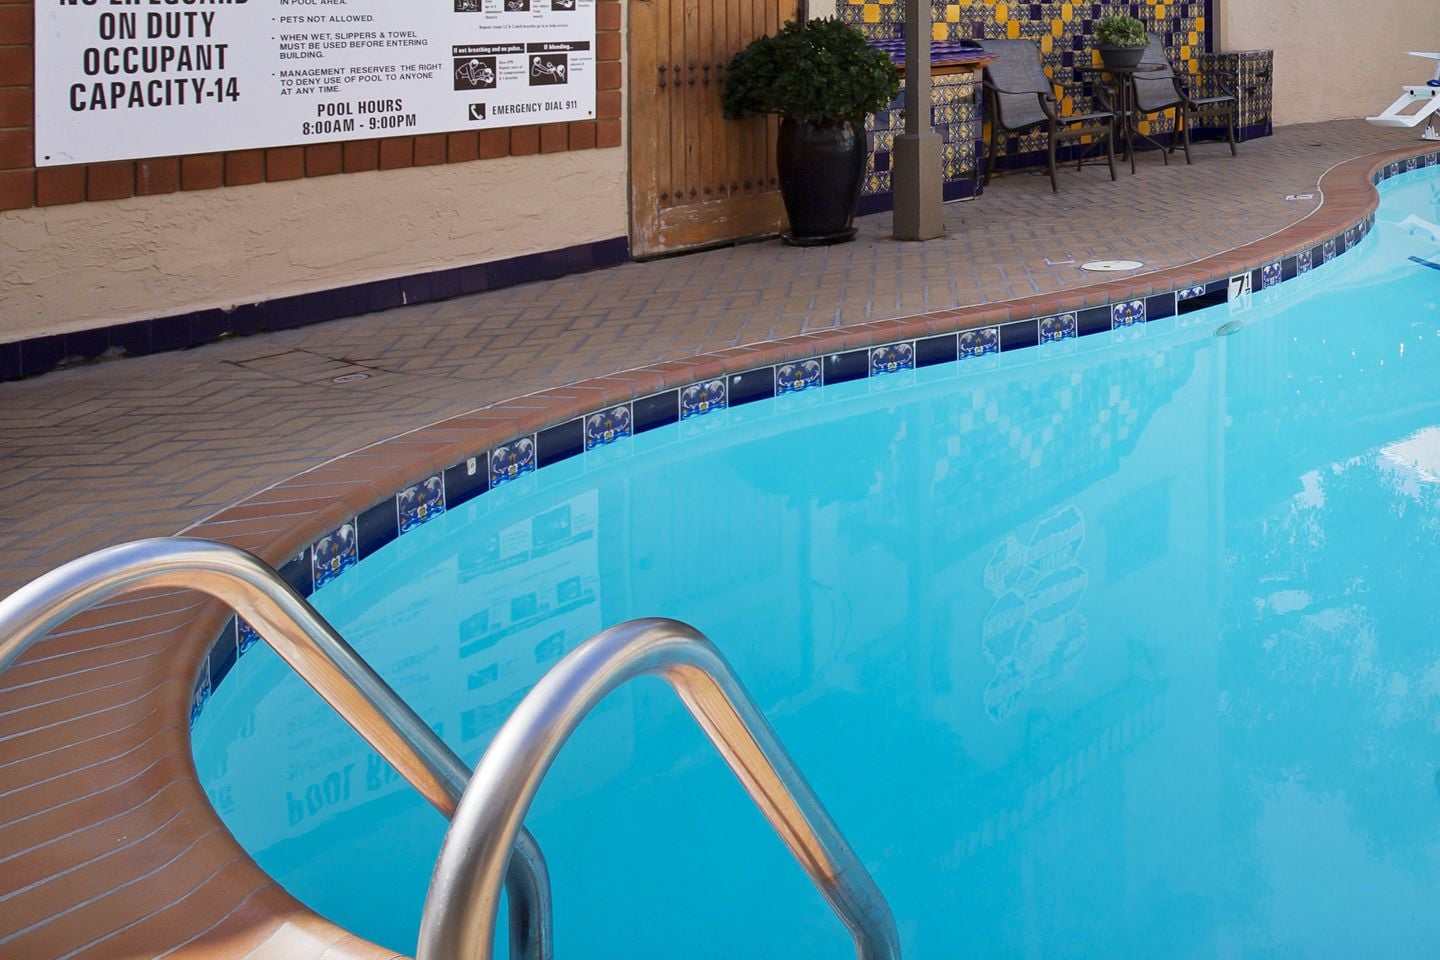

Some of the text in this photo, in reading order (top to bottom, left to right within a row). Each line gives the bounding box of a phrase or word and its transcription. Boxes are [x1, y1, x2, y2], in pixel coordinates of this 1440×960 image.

[99, 11, 215, 40] ON DUTY
[307, 15, 326, 23] NOT
[329, 15, 374, 23] ALLOWED.
[280, 33, 308, 41] WHEN
[335, 32, 377, 40] SLIPPERS
[379, 31, 385, 39] &
[280, 39, 428, 50] MUST BE USED BEFORE ENTERING
[83, 44, 228, 76] OCCUPANT
[280, 63, 443, 77] MANAGEMENT RESERVES THE RIGHT
[280, 79, 293, 87] TO
[296, 77, 321, 86] DENY
[323, 76, 342, 85] USE
[358, 74, 383, 83] POOL
[385, 73, 397, 81] TO
[399, 72, 433, 80] ANYONE
[69, 77, 240, 112] CAPACITY-14
[280, 88, 293, 96] AT
[296, 87, 315, 95] ANY
[317, 98, 402, 117] POOL HOURS
[492, 100, 577, 115] EMERGENCY DIAL 911
[302, 118, 355, 135] 8:00AM
[369, 114, 417, 131] 9:00PM
